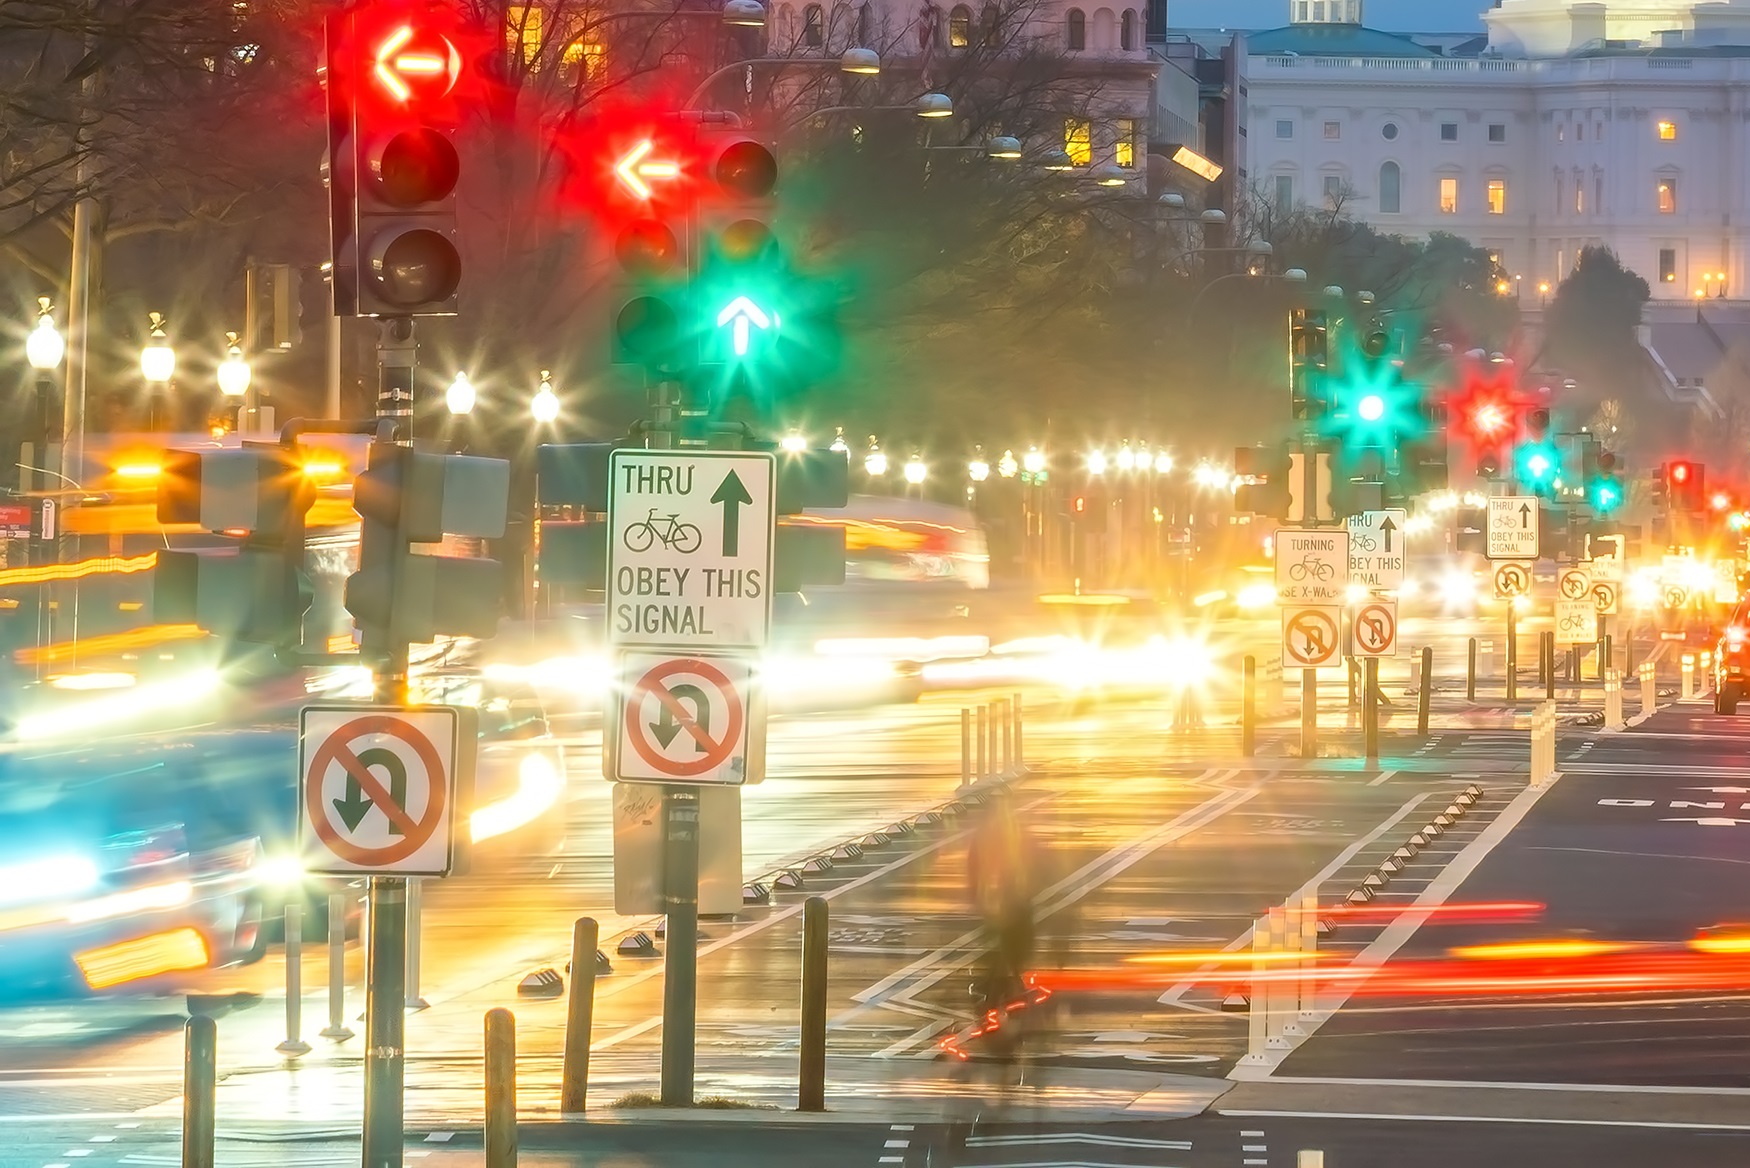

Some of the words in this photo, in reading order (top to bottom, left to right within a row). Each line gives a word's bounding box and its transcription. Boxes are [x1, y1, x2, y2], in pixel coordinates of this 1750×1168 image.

[622, 464, 695, 496] THRU
[1491, 501, 1513, 510] THRU
[1349, 514, 1372, 527] HRU
[1491, 532, 1513, 541] OBEY
[1517, 532, 1534, 541] THIS
[1291, 539, 1334, 551] TURNING
[1491, 543, 1520, 552] SIGNAL
[1350, 557, 1373, 570] BEY
[1377, 557, 1401, 570] THIS
[617, 566, 690, 597] OBEY
[702, 568, 762, 598] THIS
[1350, 573, 1381, 586] IGNAL
[616, 603, 714, 635] SIGNAL
